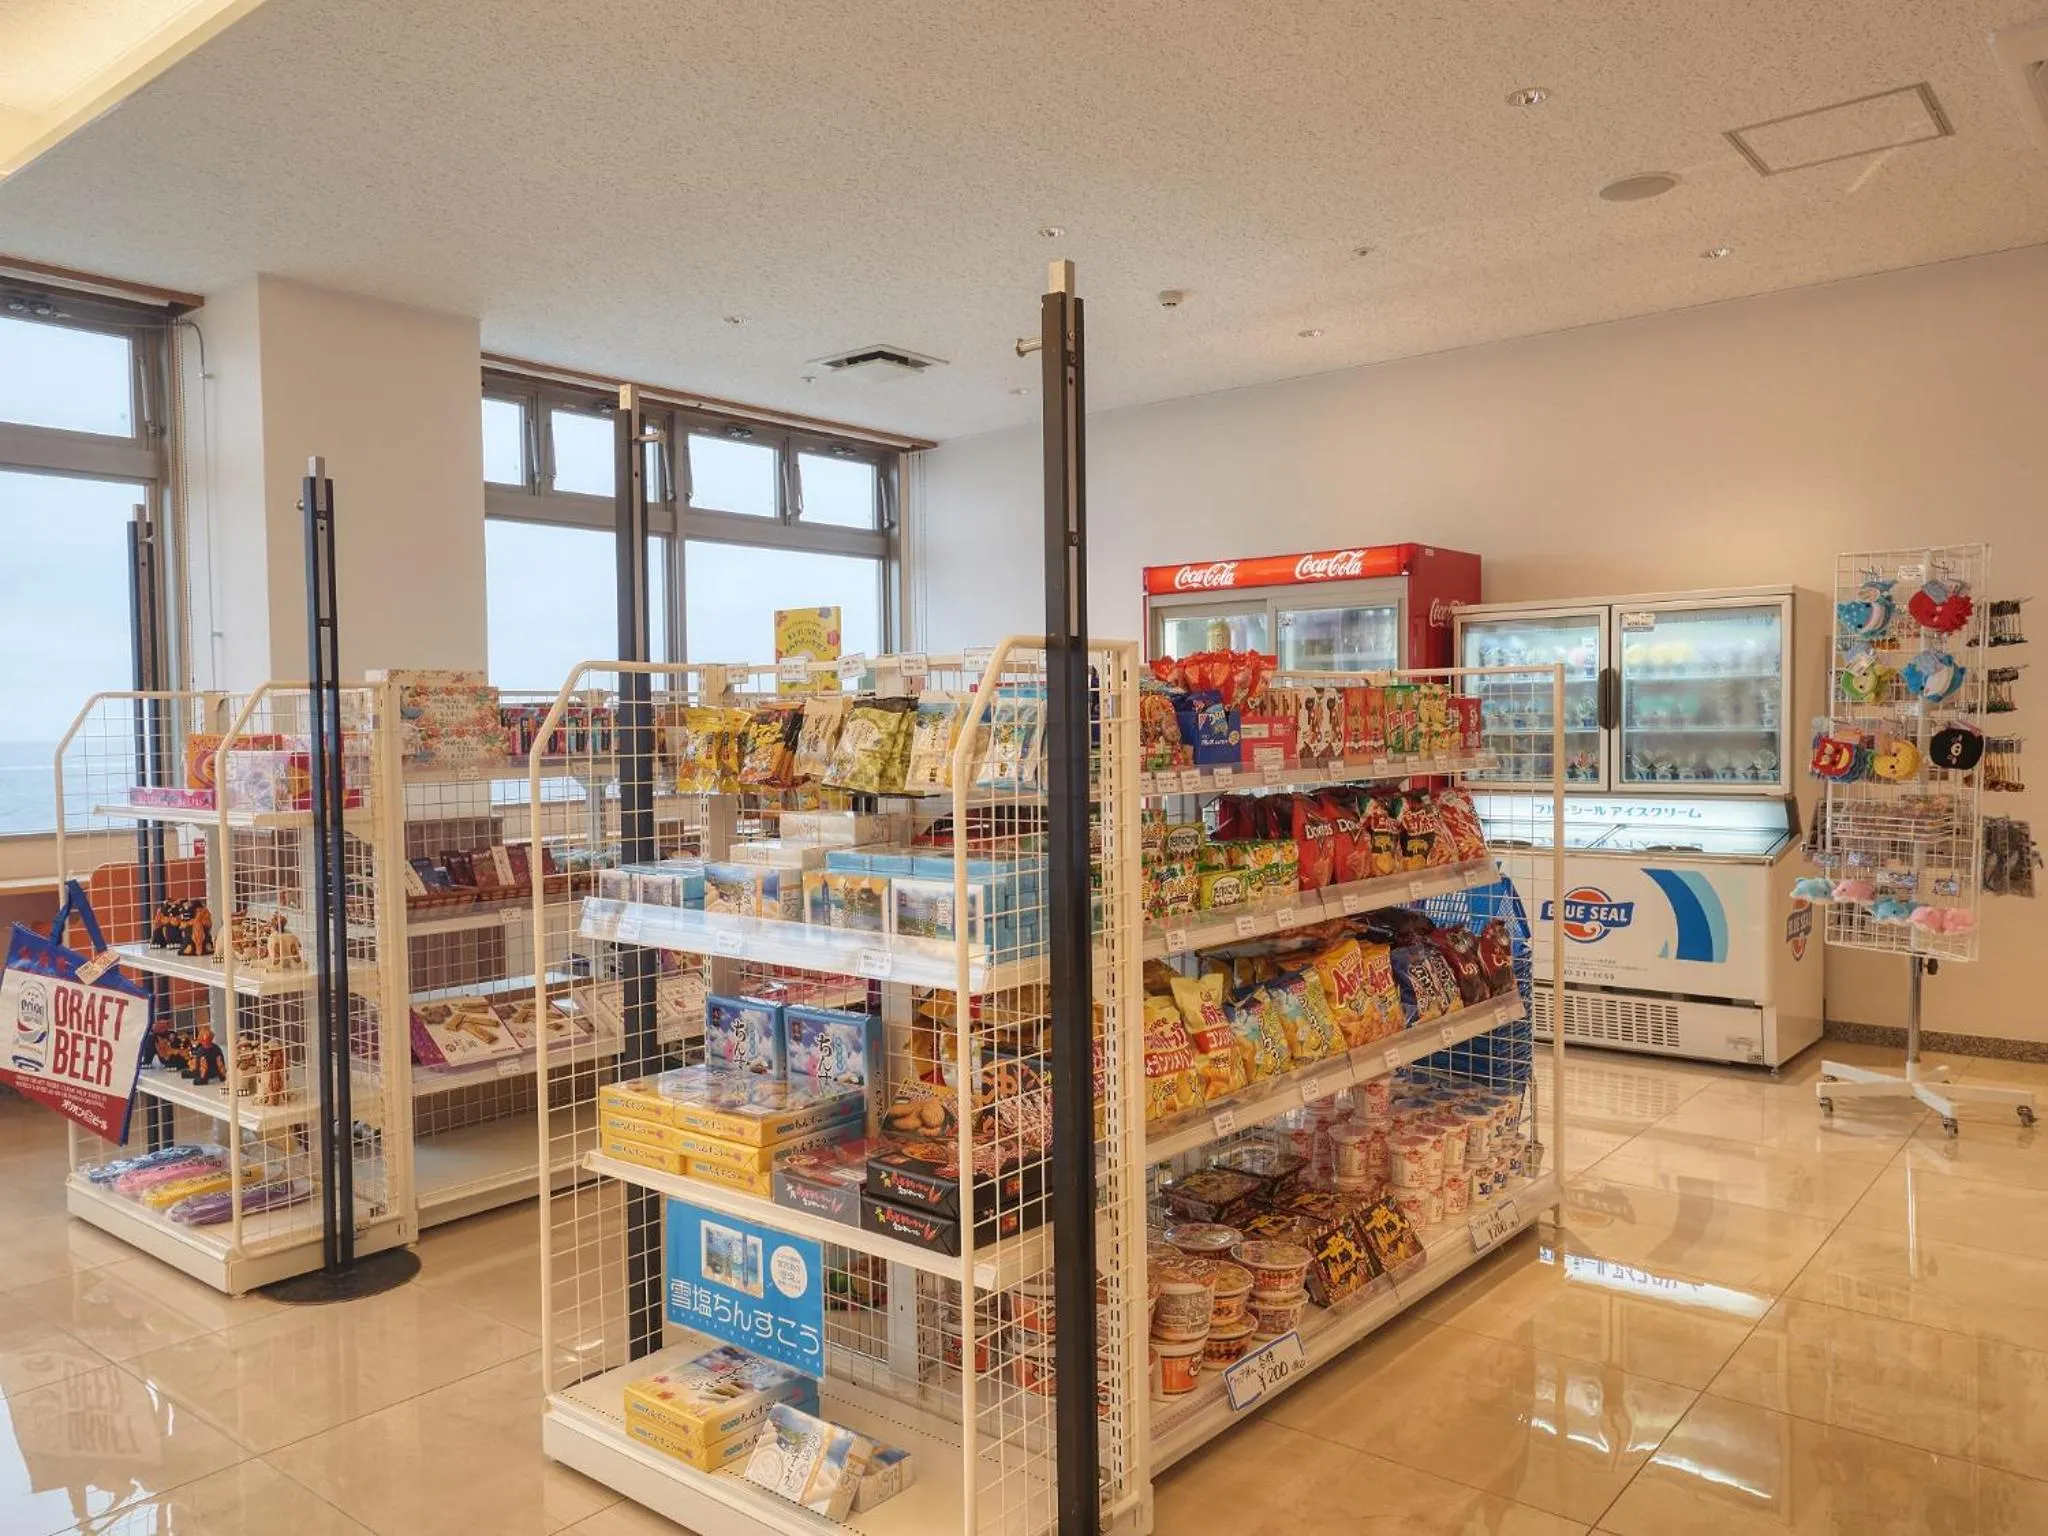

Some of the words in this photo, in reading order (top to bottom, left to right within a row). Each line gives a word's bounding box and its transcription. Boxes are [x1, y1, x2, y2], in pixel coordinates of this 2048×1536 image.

[1174, 562, 1239, 589] Coca-Cola
[1295, 550, 1368, 580] Coca-Cola
[1304, 822, 1334, 841] Doritos
[1547, 903, 1586, 919] BUE
[1588, 905, 1629, 922] SEAL
[53, 985, 129, 1041] DRAFT
[52, 1028, 114, 1087] BEER
[670, 1278, 820, 1355] 雪塩ちんすこう
[1257, 1360, 1289, 1392] ¥200
